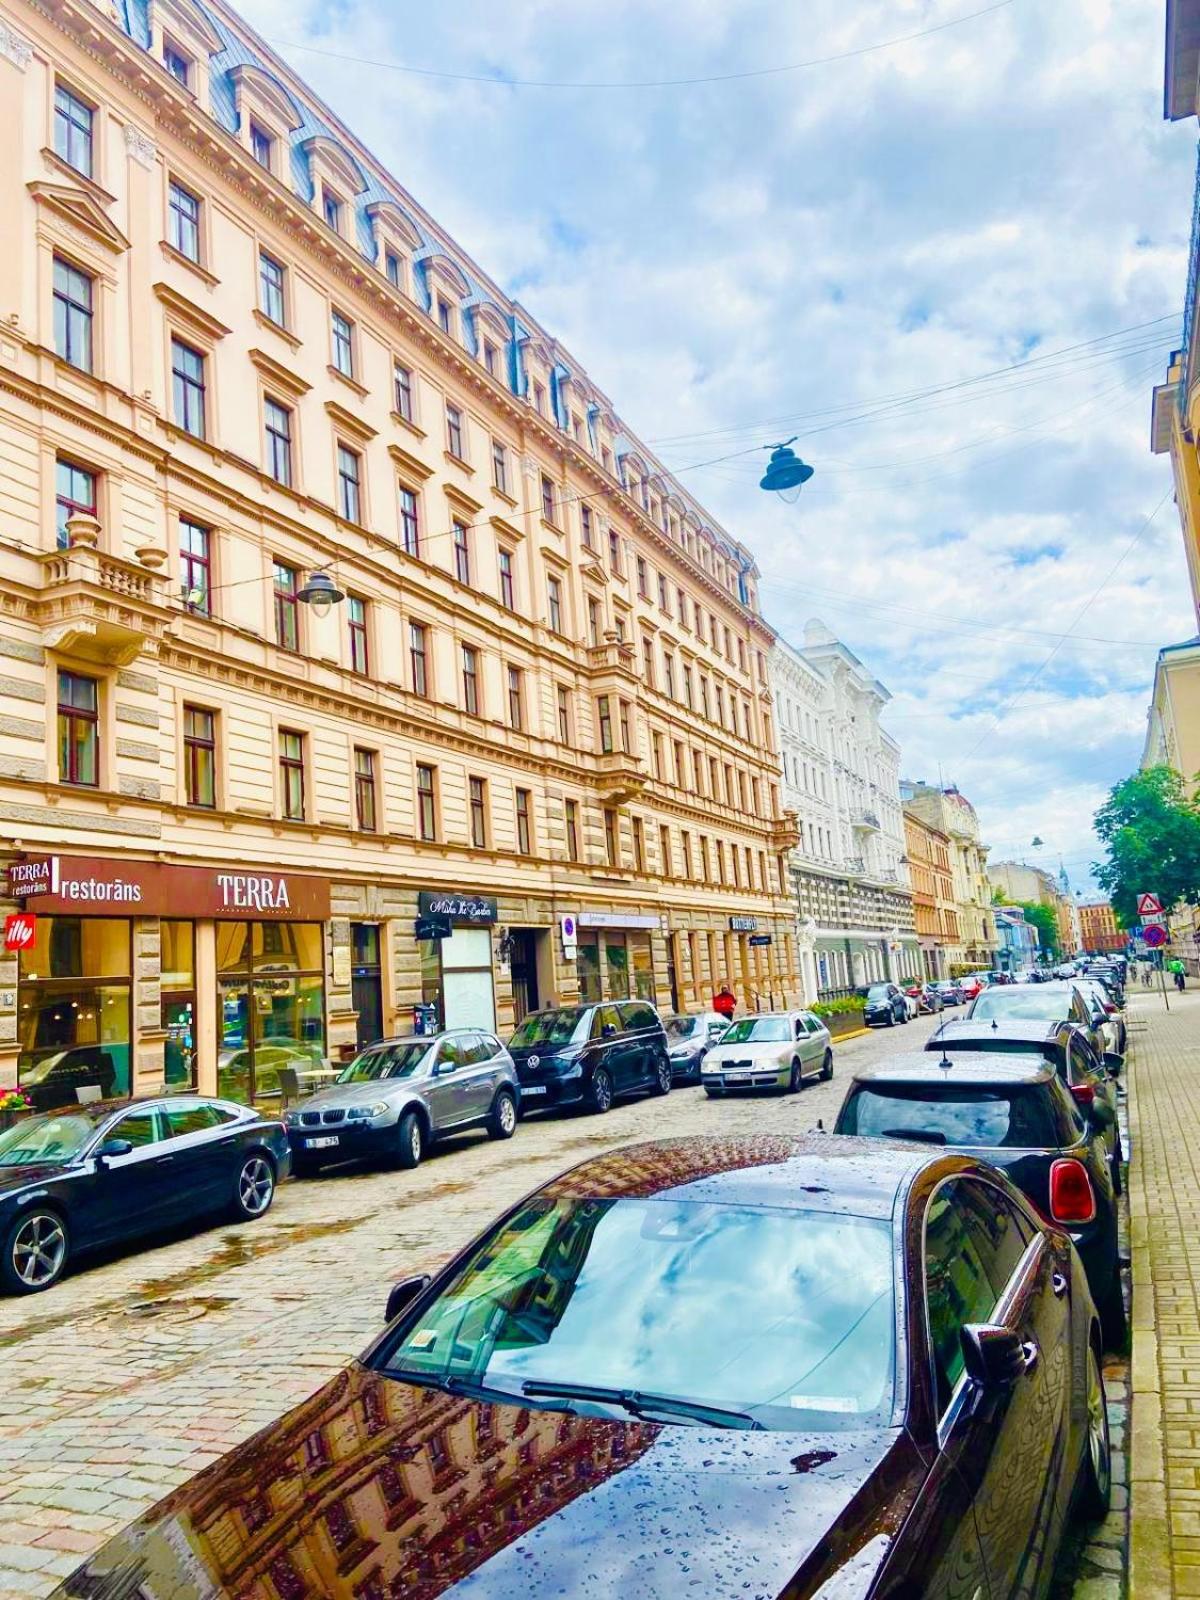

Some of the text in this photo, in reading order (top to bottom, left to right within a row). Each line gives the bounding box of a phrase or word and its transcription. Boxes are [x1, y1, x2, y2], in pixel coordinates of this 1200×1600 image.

[10, 861, 50, 881] TERRA
[61, 877, 141, 902] restorāns
[217, 874, 290, 912] TERRA
[7, 919, 33, 946] illy
